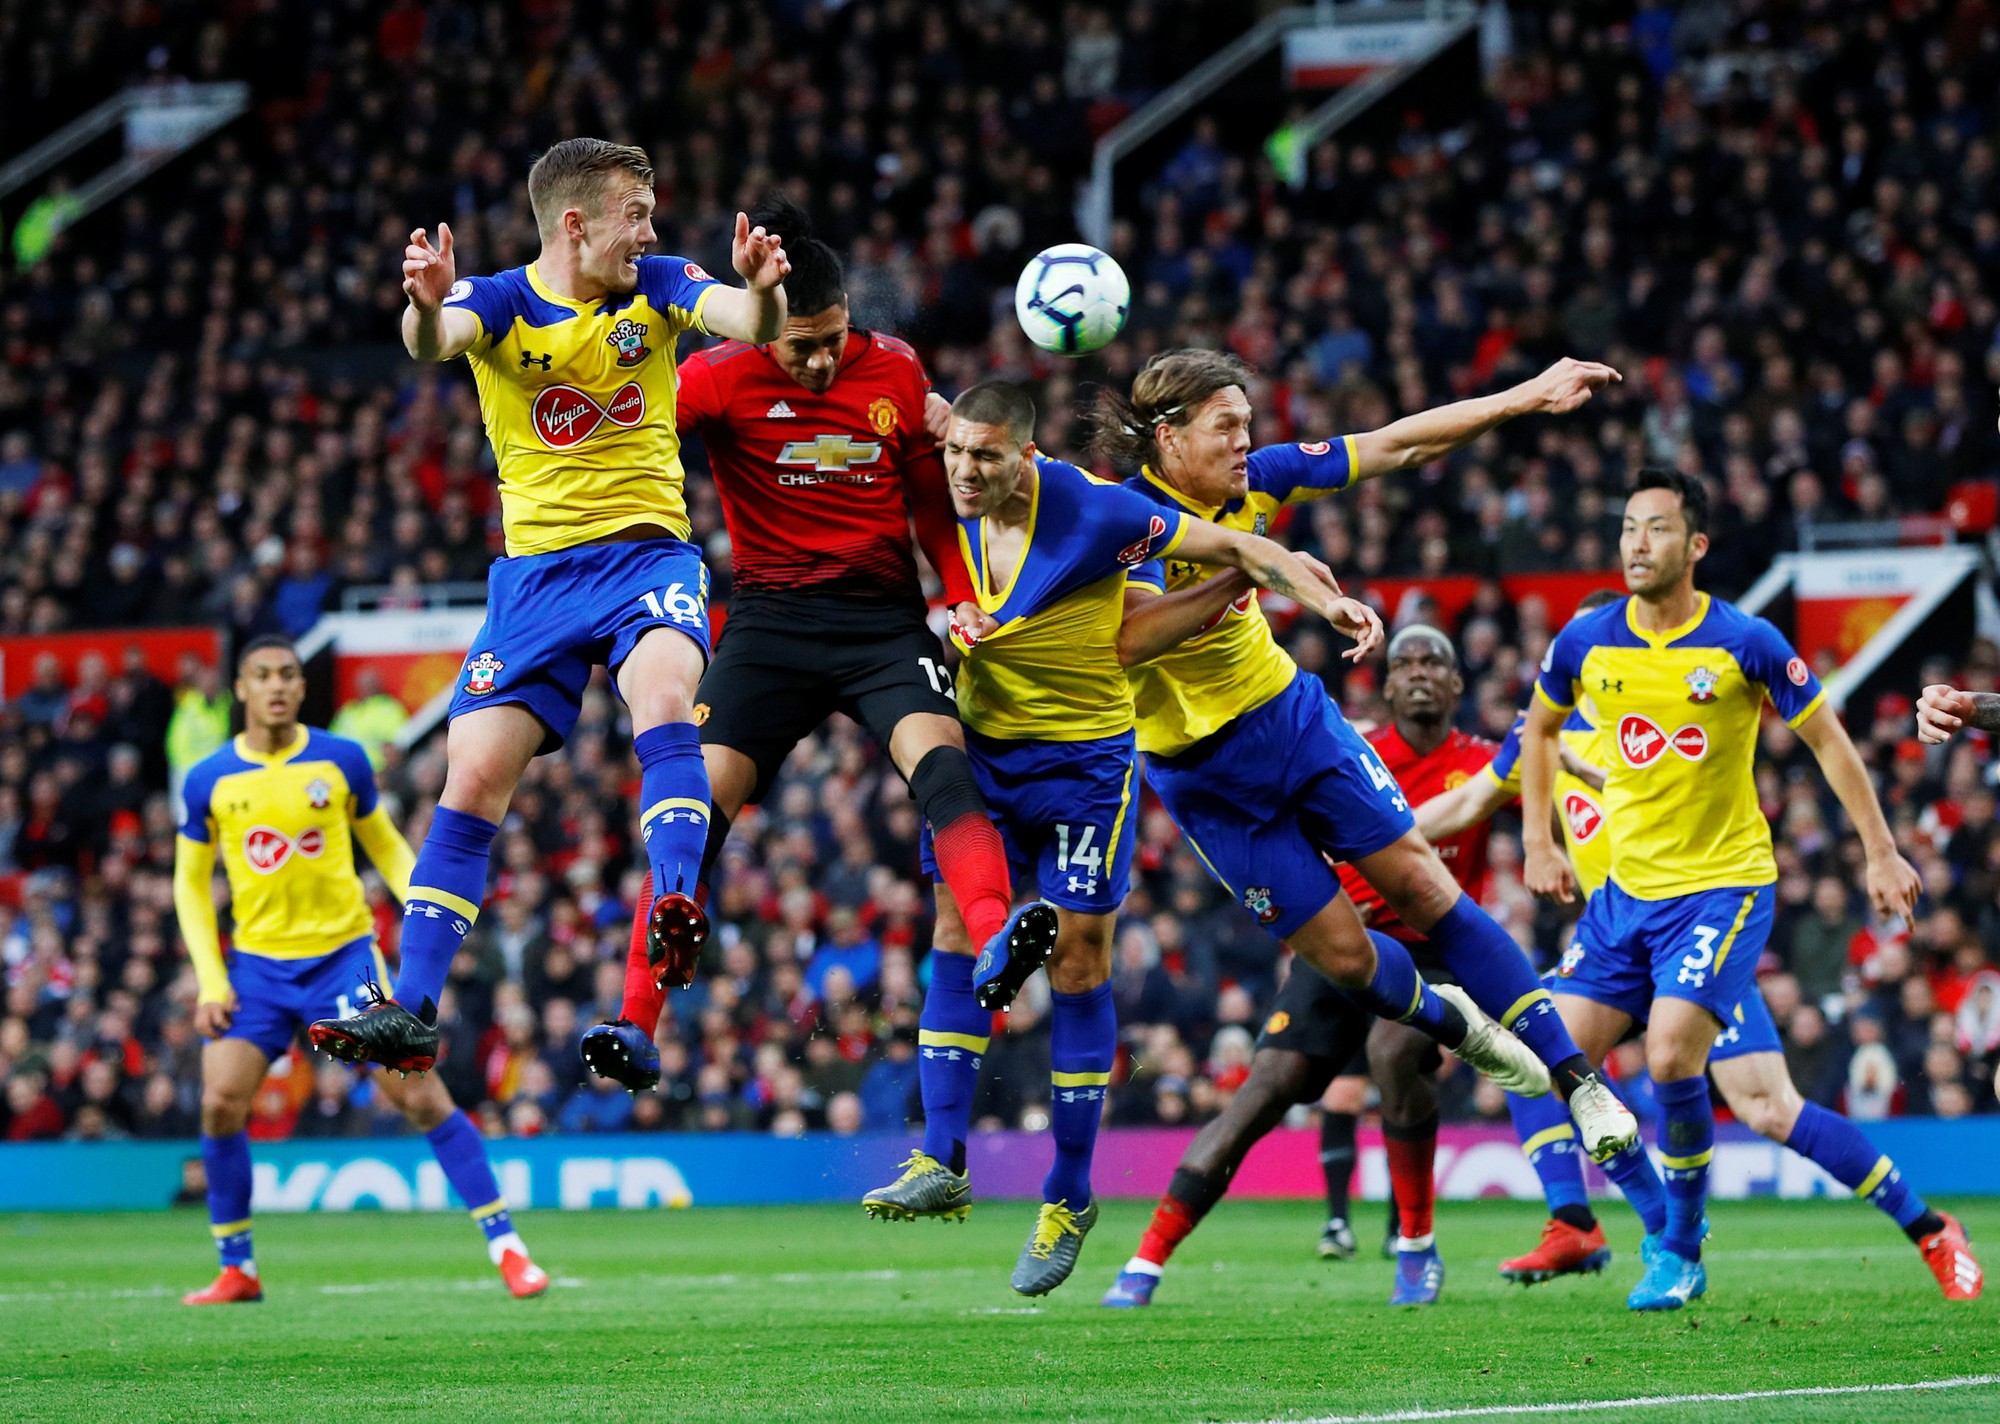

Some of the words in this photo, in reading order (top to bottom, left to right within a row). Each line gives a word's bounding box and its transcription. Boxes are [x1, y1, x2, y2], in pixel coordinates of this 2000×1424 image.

[541, 397, 590, 436] Virgin
[611, 396, 641, 414] media
[778, 472, 877, 485] CHEVOLE
[638, 582, 699, 618] 16
[918, 656, 957, 701] 12
[1359, 752, 1397, 792] 4
[1055, 823, 1103, 876] 14
[1682, 924, 1720, 970] 3
